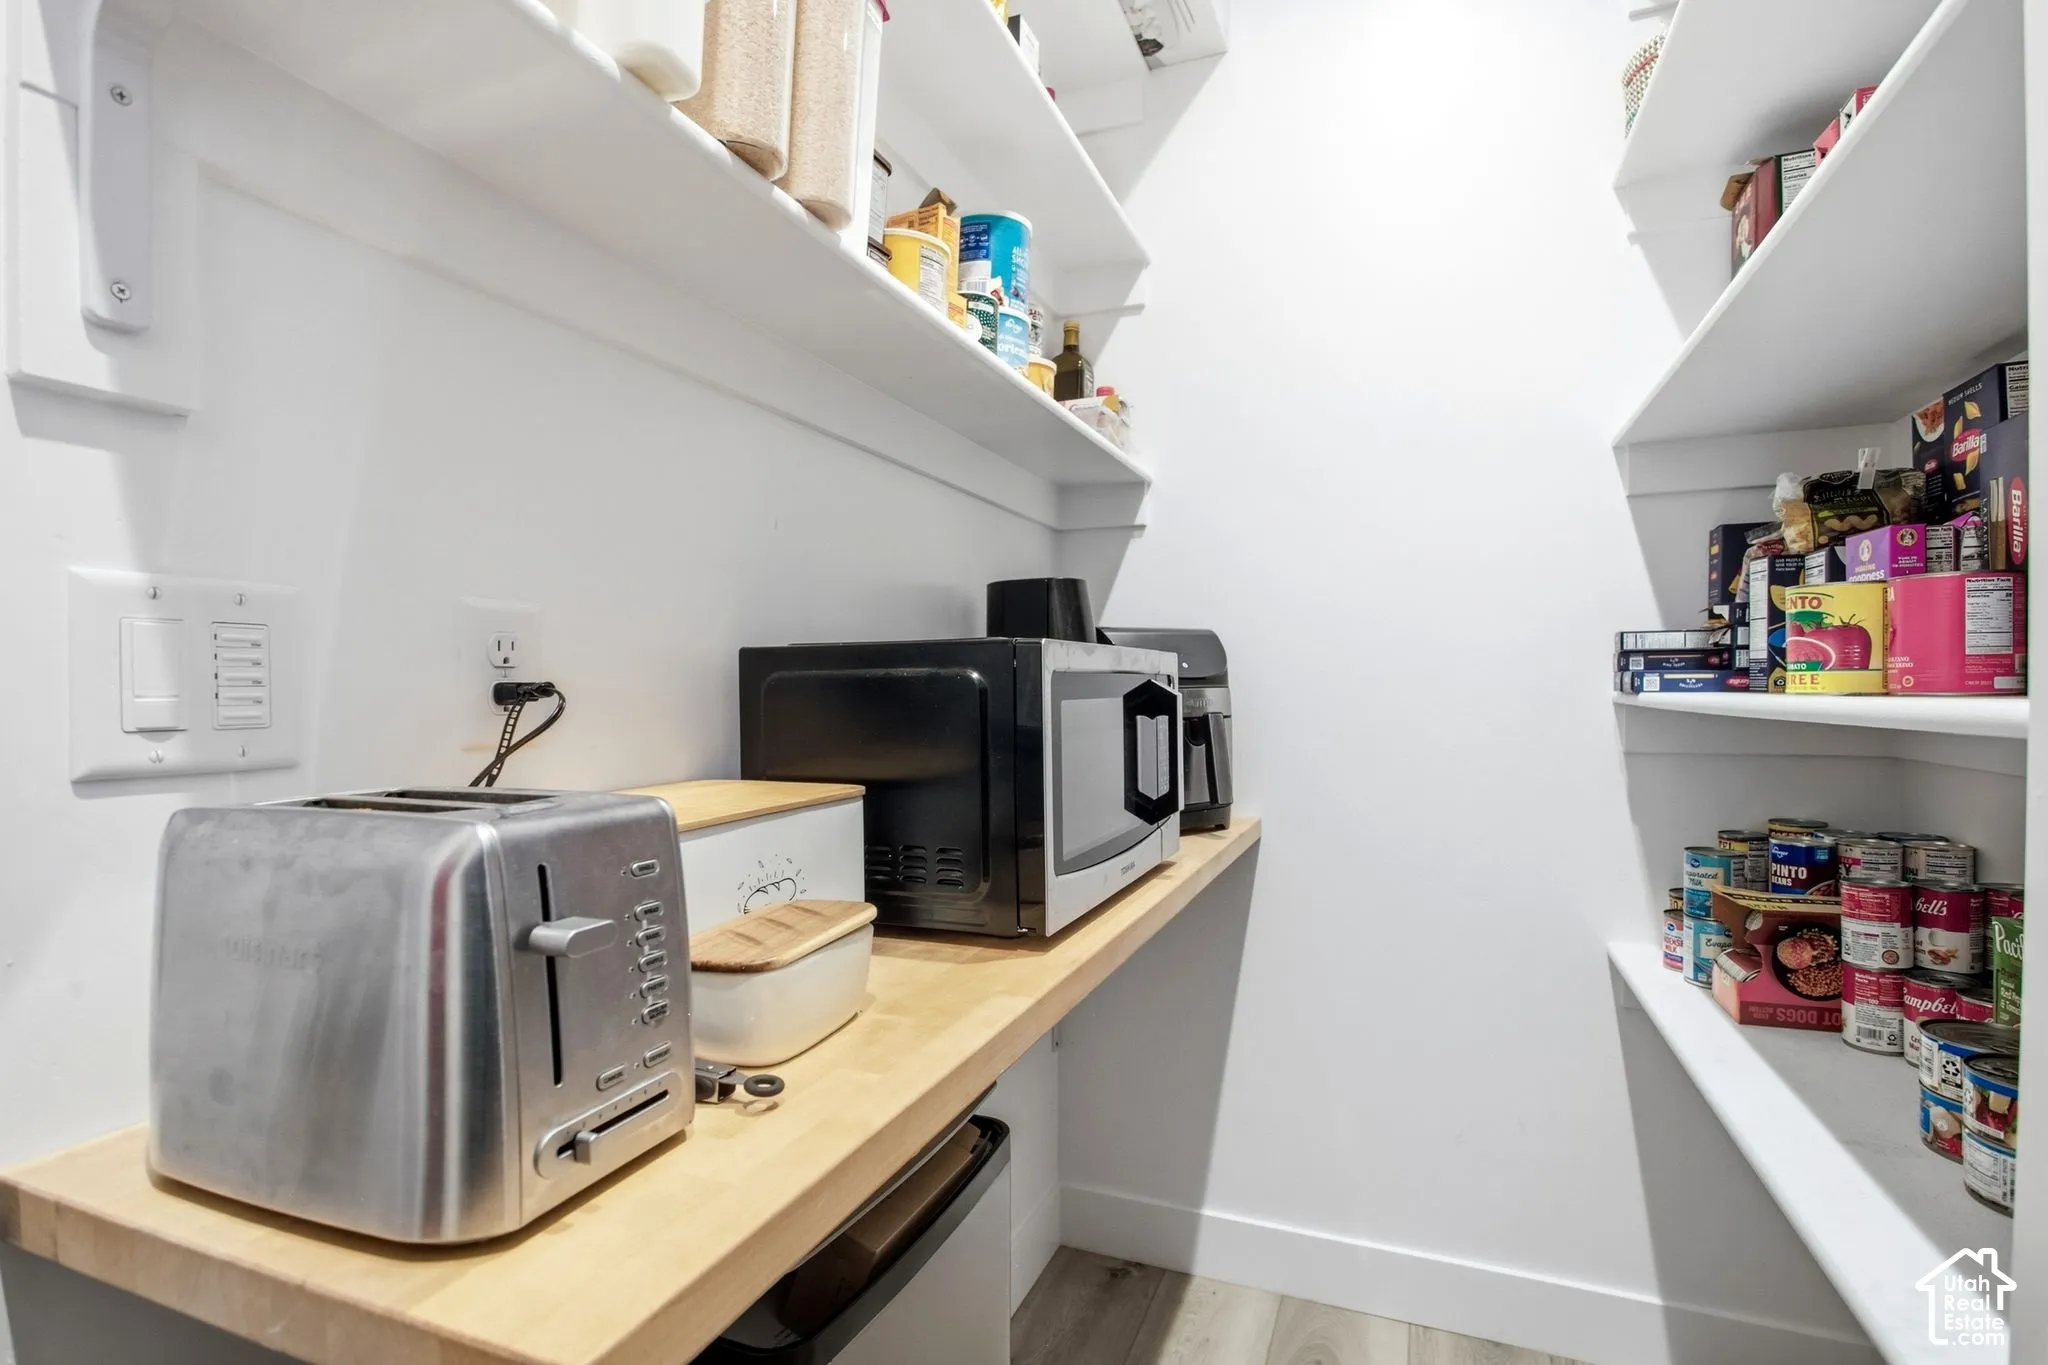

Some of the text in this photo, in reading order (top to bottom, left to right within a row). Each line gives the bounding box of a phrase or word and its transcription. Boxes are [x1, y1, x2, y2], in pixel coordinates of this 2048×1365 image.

[1964, 382, 1983, 398] SHELLS
[1952, 434, 1980, 458] Barilla
[2011, 489, 2024, 553] Barilla
[1787, 673, 1820, 685] REE
[1771, 863, 1808, 880] PINTO
[1771, 875, 1793, 887] BEANS
[1776, 1008, 1818, 1024] DOGS
